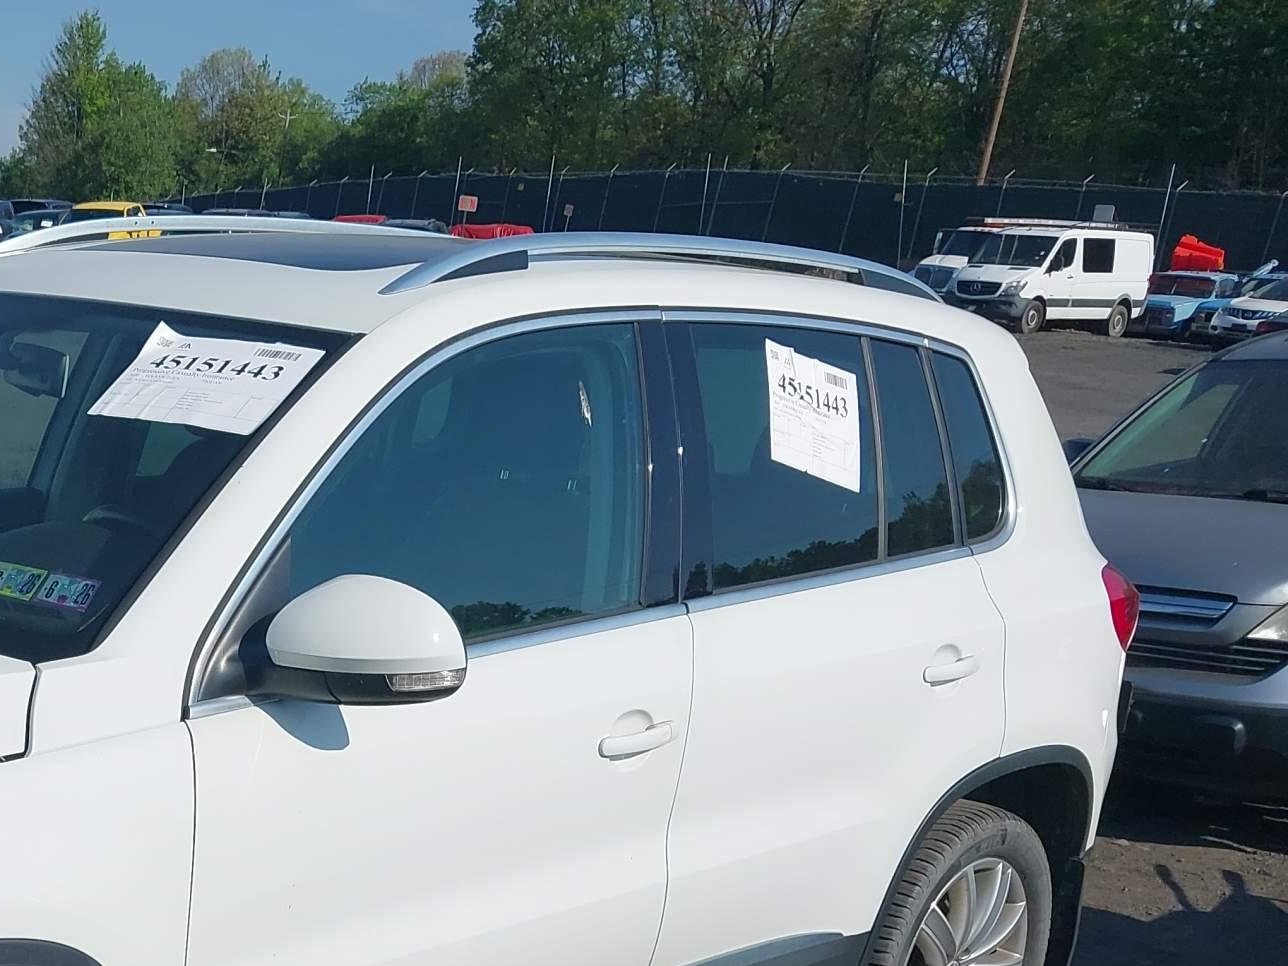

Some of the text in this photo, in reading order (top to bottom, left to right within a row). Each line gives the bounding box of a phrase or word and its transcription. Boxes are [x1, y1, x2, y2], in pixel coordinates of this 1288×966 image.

[150, 354, 285, 381] 45151443
[778, 373, 848, 418] 45151443
[18, 573, 42, 595] 26
[73, 583, 96, 606] 26
